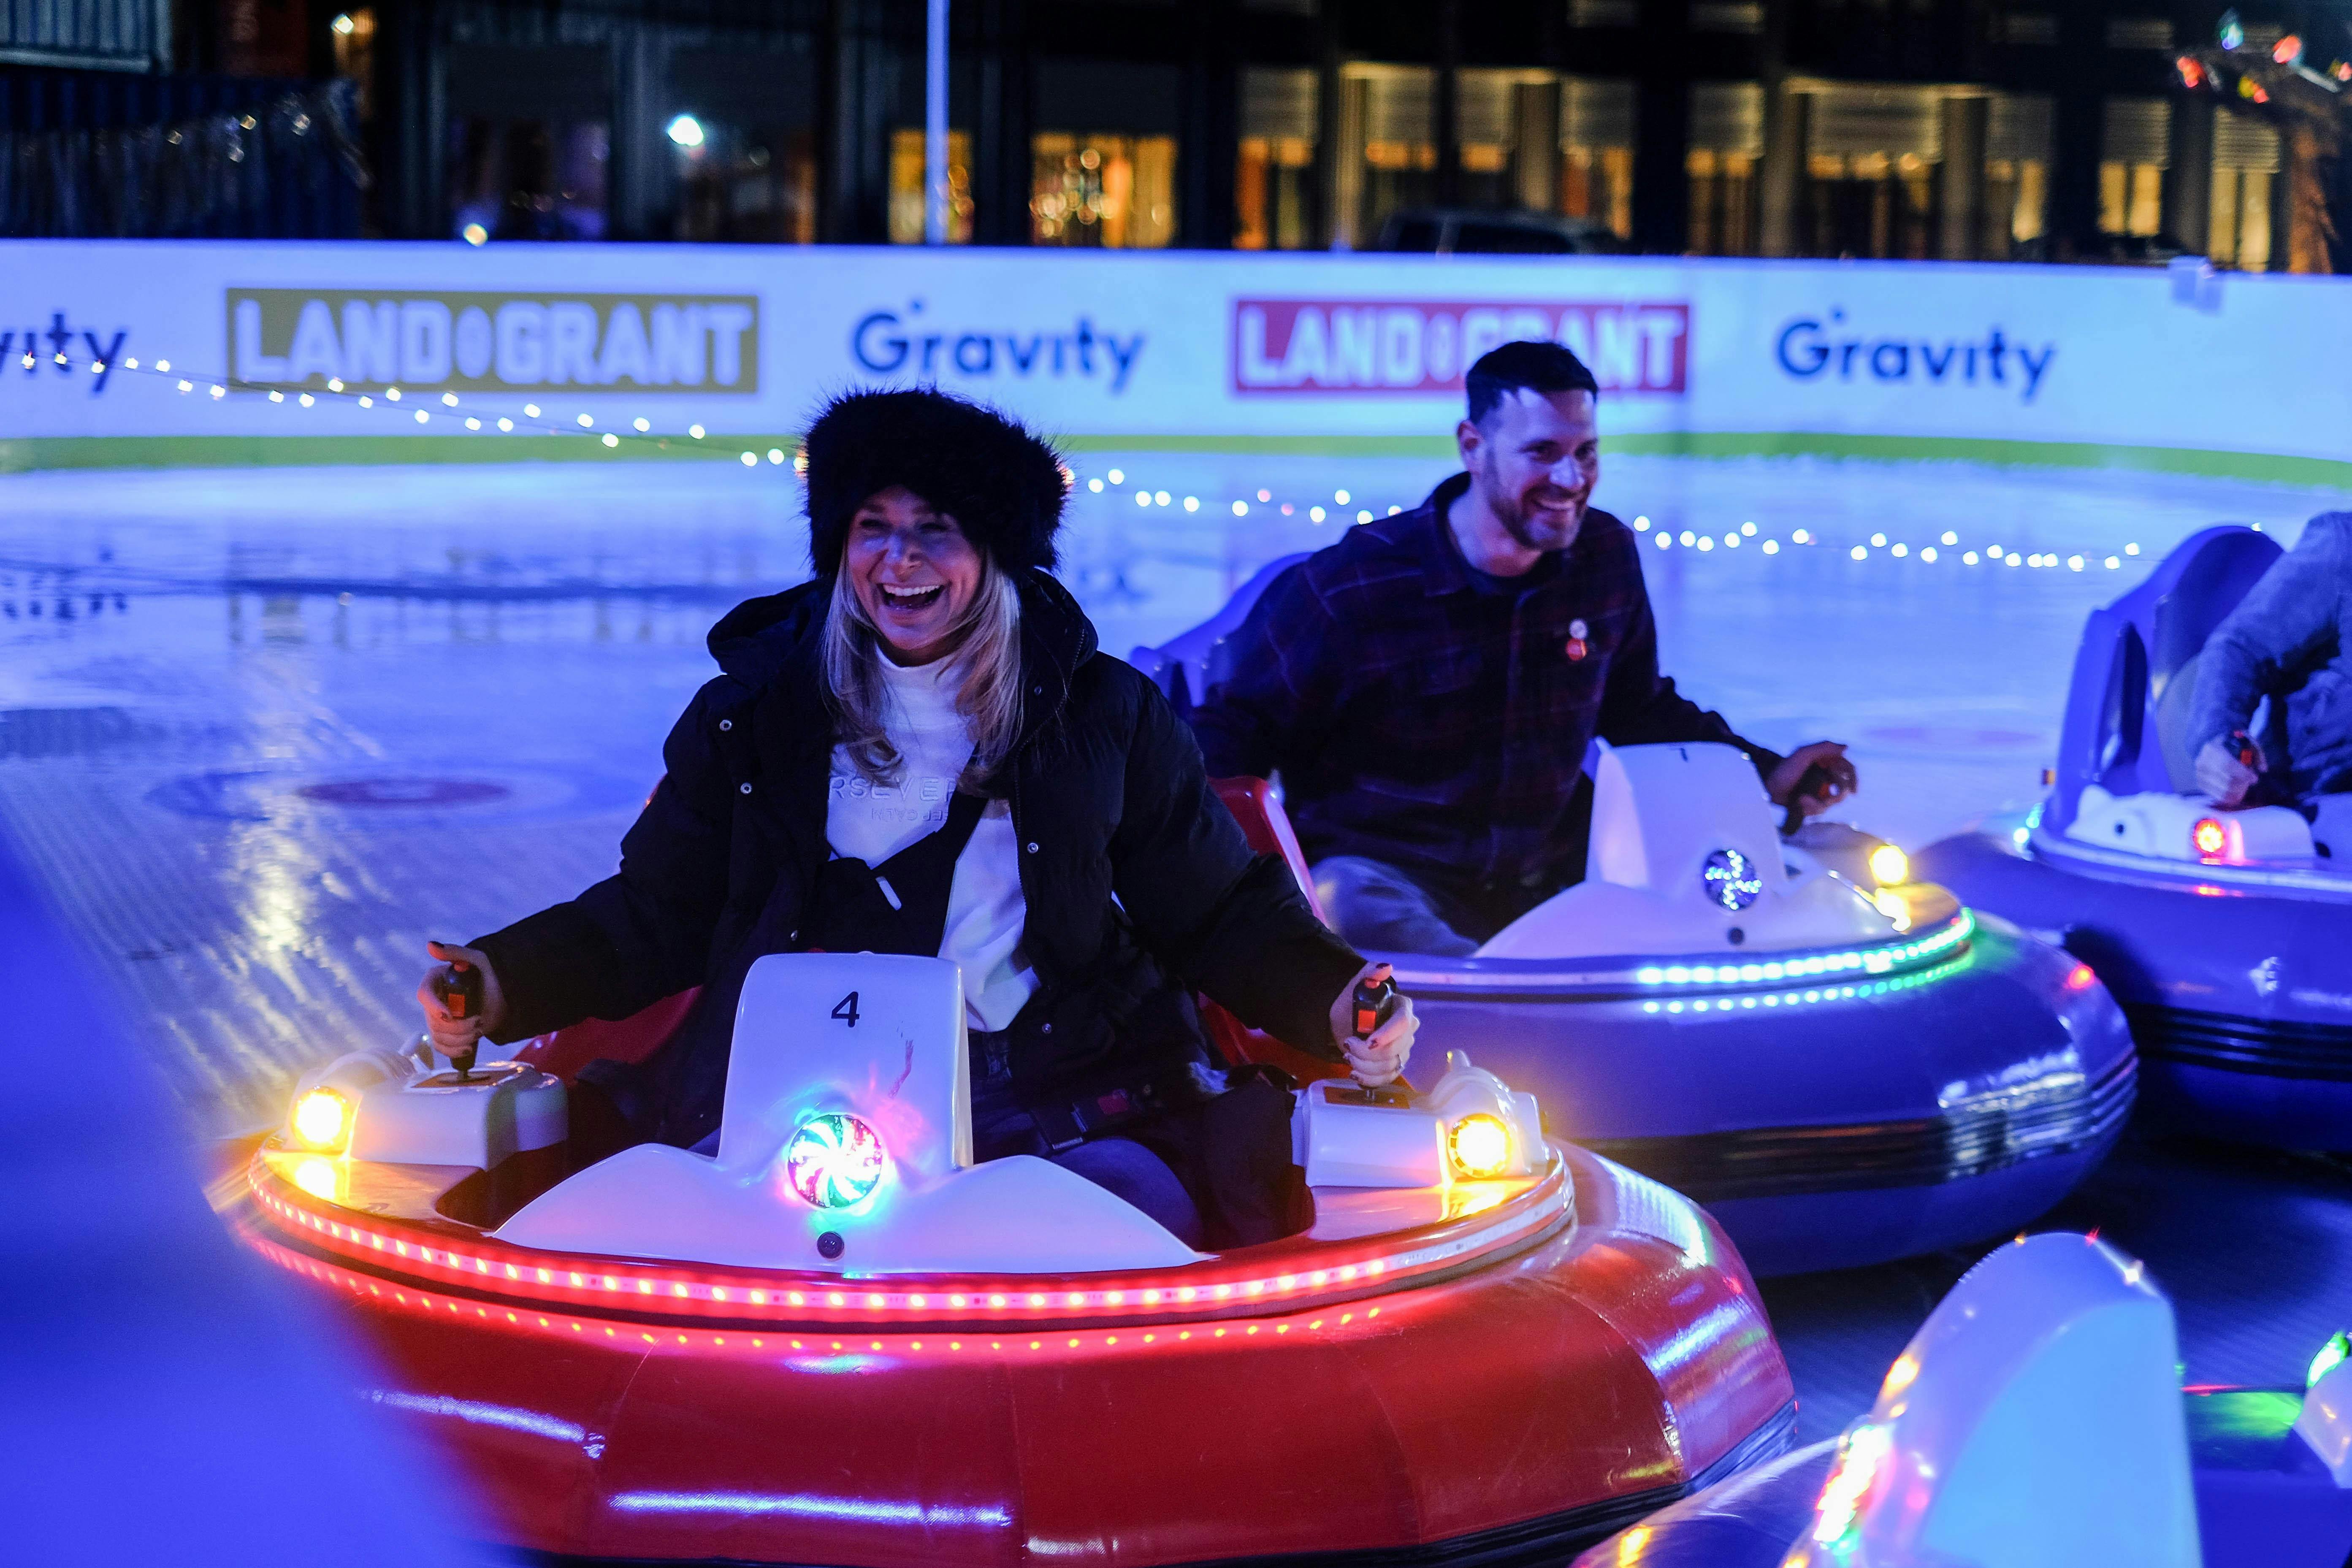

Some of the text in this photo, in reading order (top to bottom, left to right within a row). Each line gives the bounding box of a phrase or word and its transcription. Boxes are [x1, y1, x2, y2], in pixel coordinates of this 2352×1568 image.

[236, 299, 753, 386] LAND GRANT
[854, 299, 1143, 393] Gravity
[1238, 306, 1429, 387] LAND
[1778, 309, 2053, 401] Gravity
[831, 991, 860, 1028] 4
